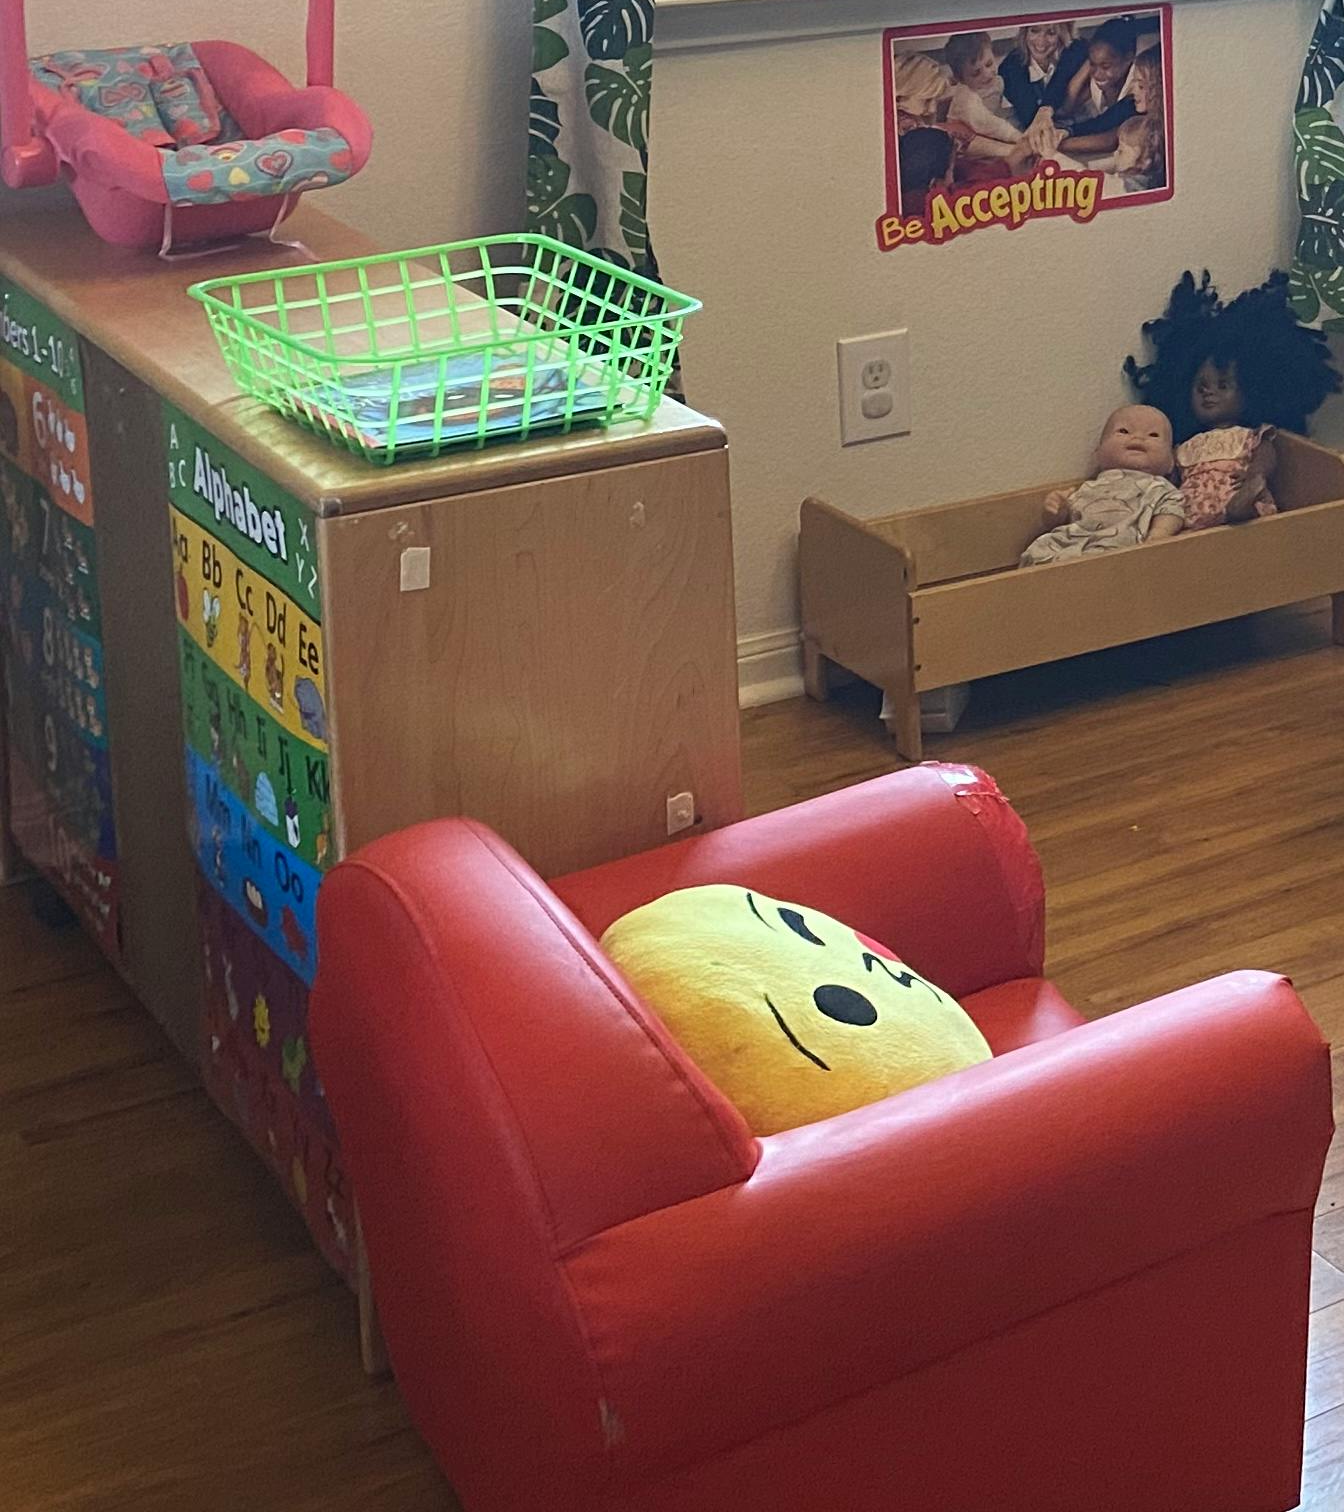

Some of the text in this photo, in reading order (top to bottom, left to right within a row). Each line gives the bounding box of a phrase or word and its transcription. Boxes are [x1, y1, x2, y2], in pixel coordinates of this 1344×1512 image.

[882, 166, 1098, 247] Be Accepting
[193, 446, 288, 562] Alphabet
[202, 540, 223, 589] Bb
[235, 569, 254, 617] Cc
[266, 591, 287, 648] Dd
[299, 624, 320, 676] Ee
